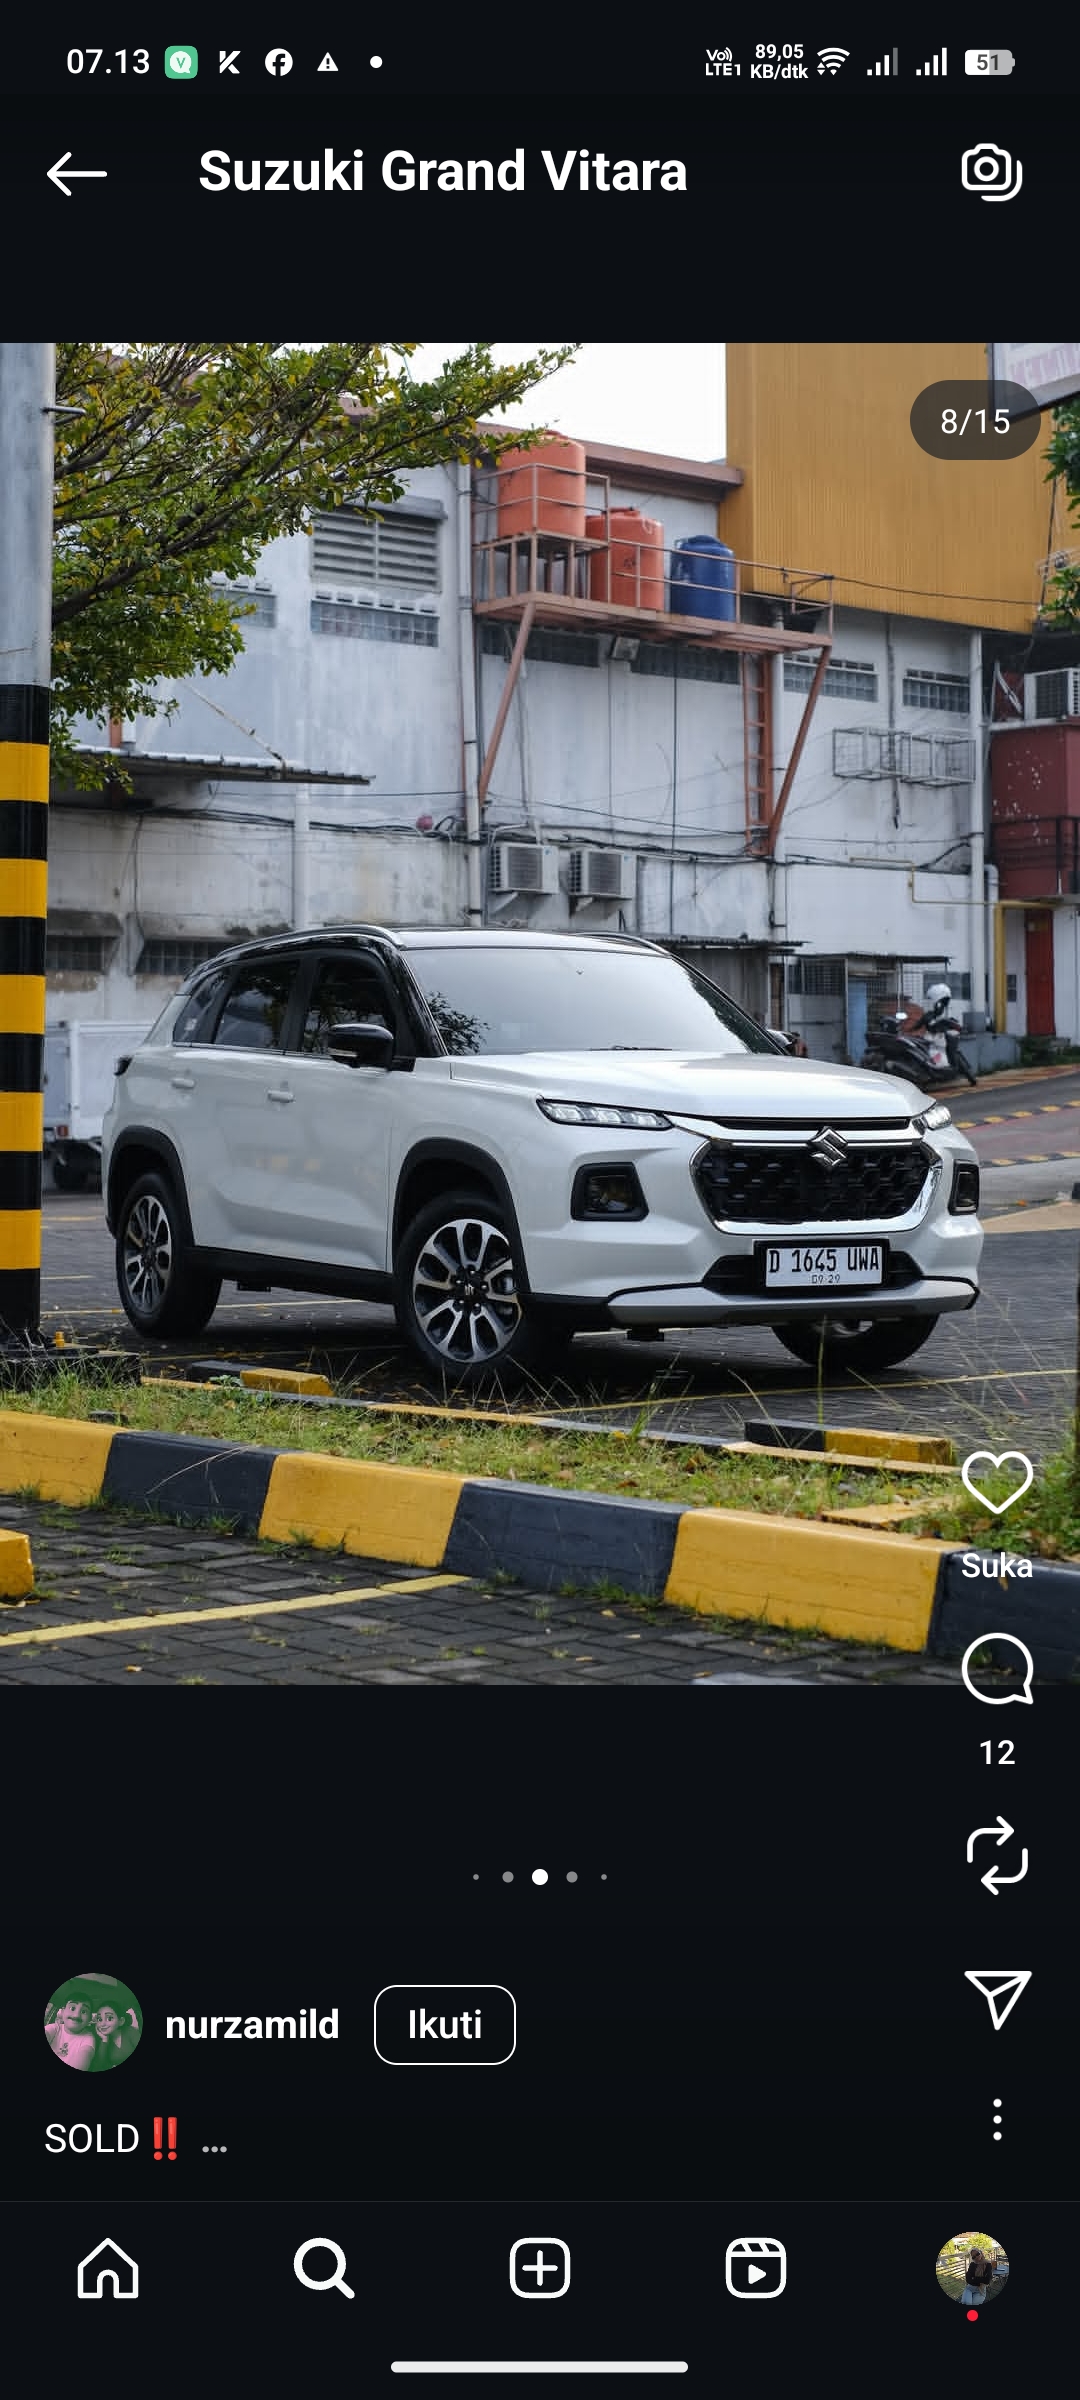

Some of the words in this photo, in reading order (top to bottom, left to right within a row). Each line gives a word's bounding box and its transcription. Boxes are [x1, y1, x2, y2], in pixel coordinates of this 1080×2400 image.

[768, 1249, 780, 1273] D
[791, 1248, 838, 1272] 1645
[847, 1246, 880, 1271] UWA
